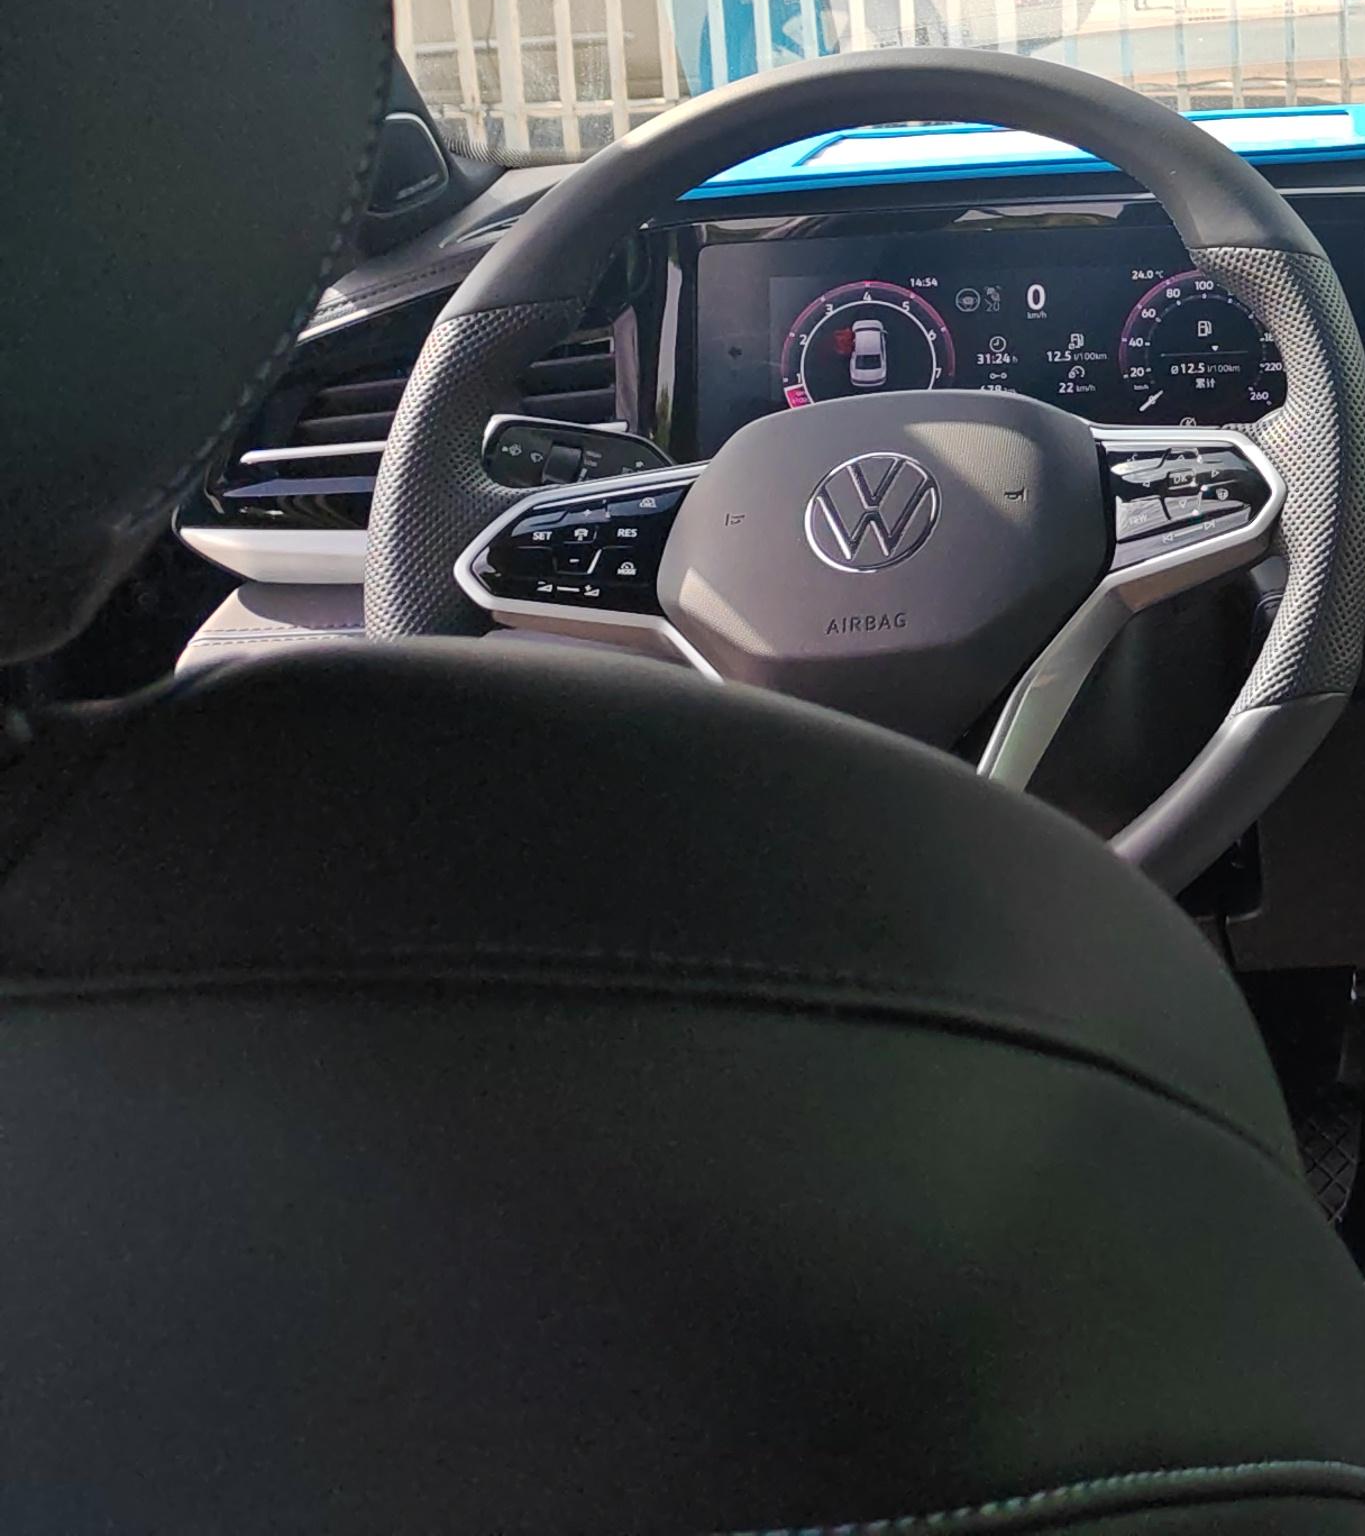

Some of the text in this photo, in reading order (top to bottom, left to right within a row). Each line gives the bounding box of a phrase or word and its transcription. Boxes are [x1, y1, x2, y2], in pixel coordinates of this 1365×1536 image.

[1131, 270, 1153, 279] 24.0
[910, 277, 939, 287] 14:54
[1194, 281, 1214, 290] 100
[1026, 284, 1046, 310] 0
[1166, 288, 1181, 298] 80
[1026, 311, 1047, 319] km/h
[1141, 309, 1156, 318] 60
[1129, 337, 1144, 347] 40
[976, 353, 1011, 365] 31:24
[1046, 350, 1072, 362] 12.5
[1180, 363, 1205, 374] 12.5
[1264, 362, 1283, 371] 220
[1130, 368, 1145, 377] 20
[1058, 382, 1096, 393] 22 km/h
[1195, 377, 1216, 389] 累计
[1250, 391, 1269, 401] 260
[532, 531, 553, 541] SET
[616, 528, 638, 538] RES
[616, 568, 637, 576] MODE
[825, 612, 907, 635] AIRBAG
